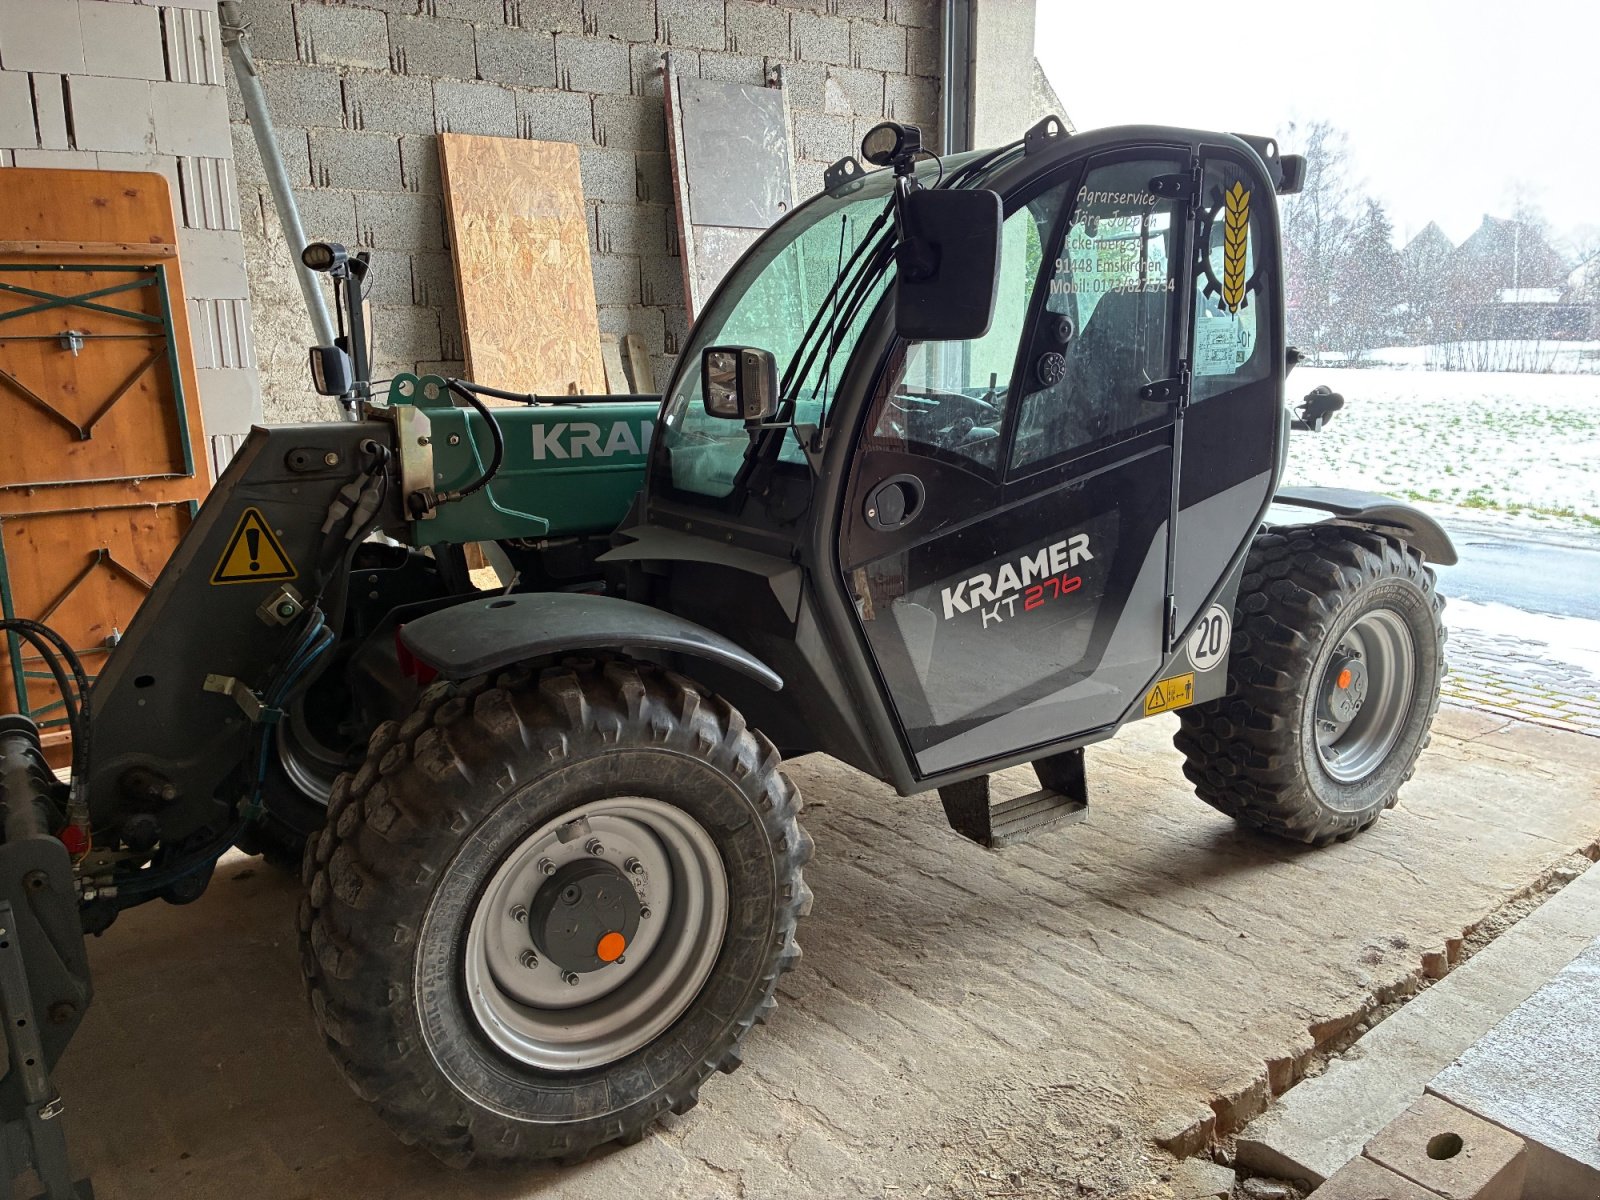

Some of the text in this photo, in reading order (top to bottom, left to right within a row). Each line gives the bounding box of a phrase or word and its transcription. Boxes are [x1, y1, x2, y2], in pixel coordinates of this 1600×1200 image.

[1076, 185, 1156, 208] Agrarservice
[1064, 234, 1127, 254] Eckenberg
[1055, 257, 1162, 274] 91448 Emskirchen
[1049, 278, 1090, 295] Mobil:
[940, 533, 1095, 621] KRAMER
[981, 572, 1082, 630] KT 276
[1195, 614, 1223, 659] 20
